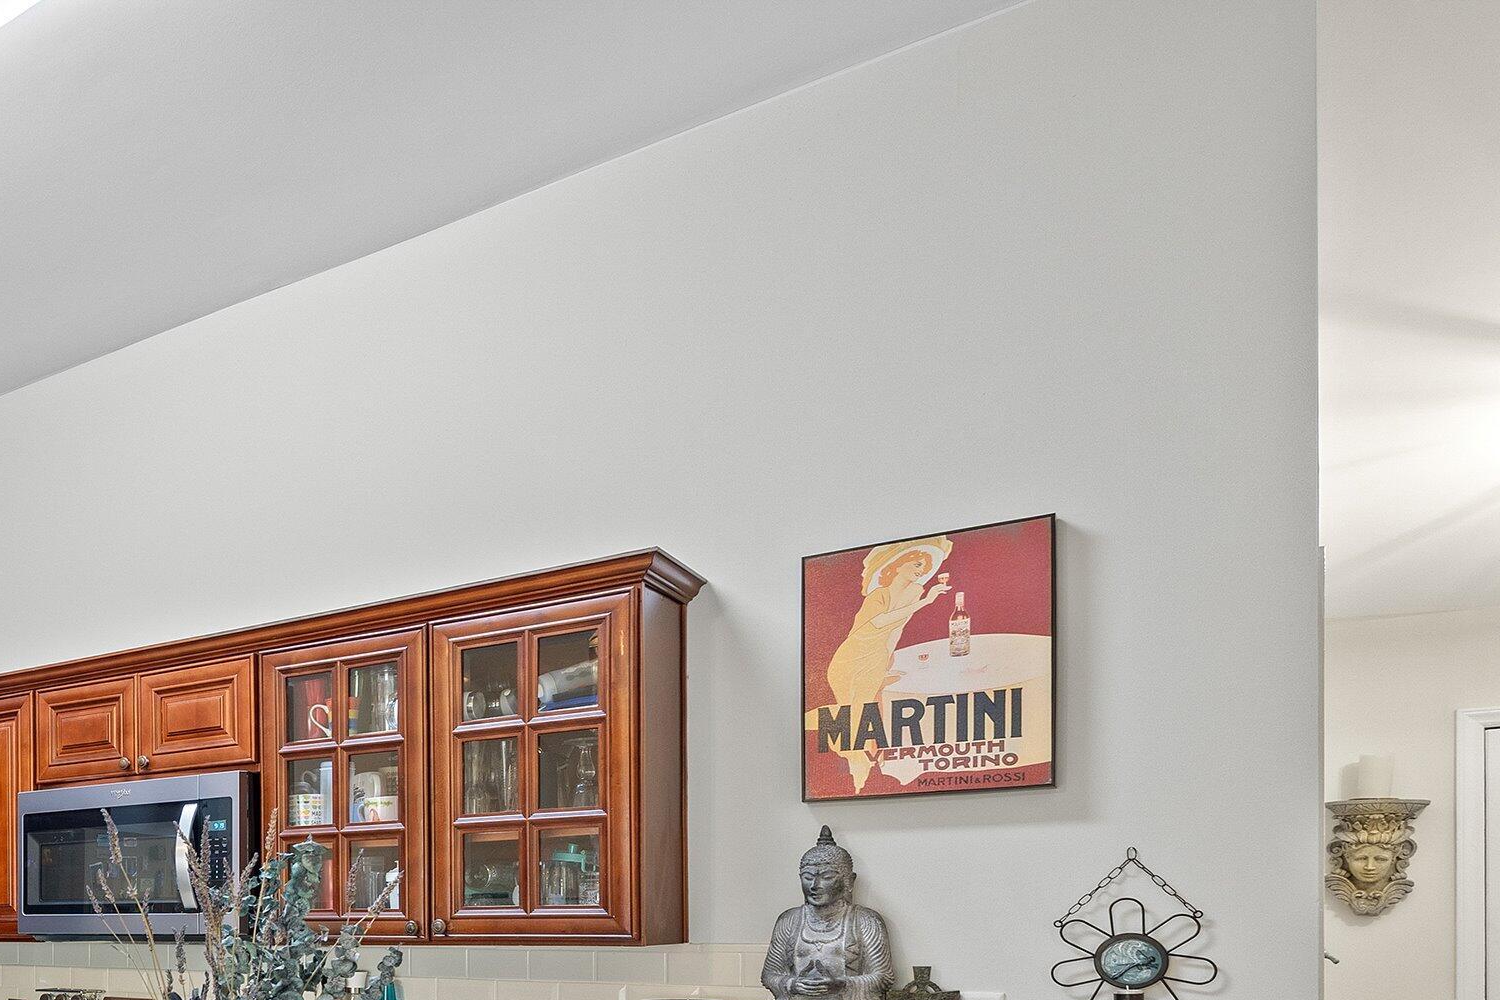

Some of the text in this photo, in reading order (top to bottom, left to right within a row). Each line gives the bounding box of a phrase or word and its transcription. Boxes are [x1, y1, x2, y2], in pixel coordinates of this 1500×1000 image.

[817, 687, 1023, 753] MARTINI
[864, 739, 1005, 763] VERMOUTH
[918, 752, 1019, 772] TORINO
